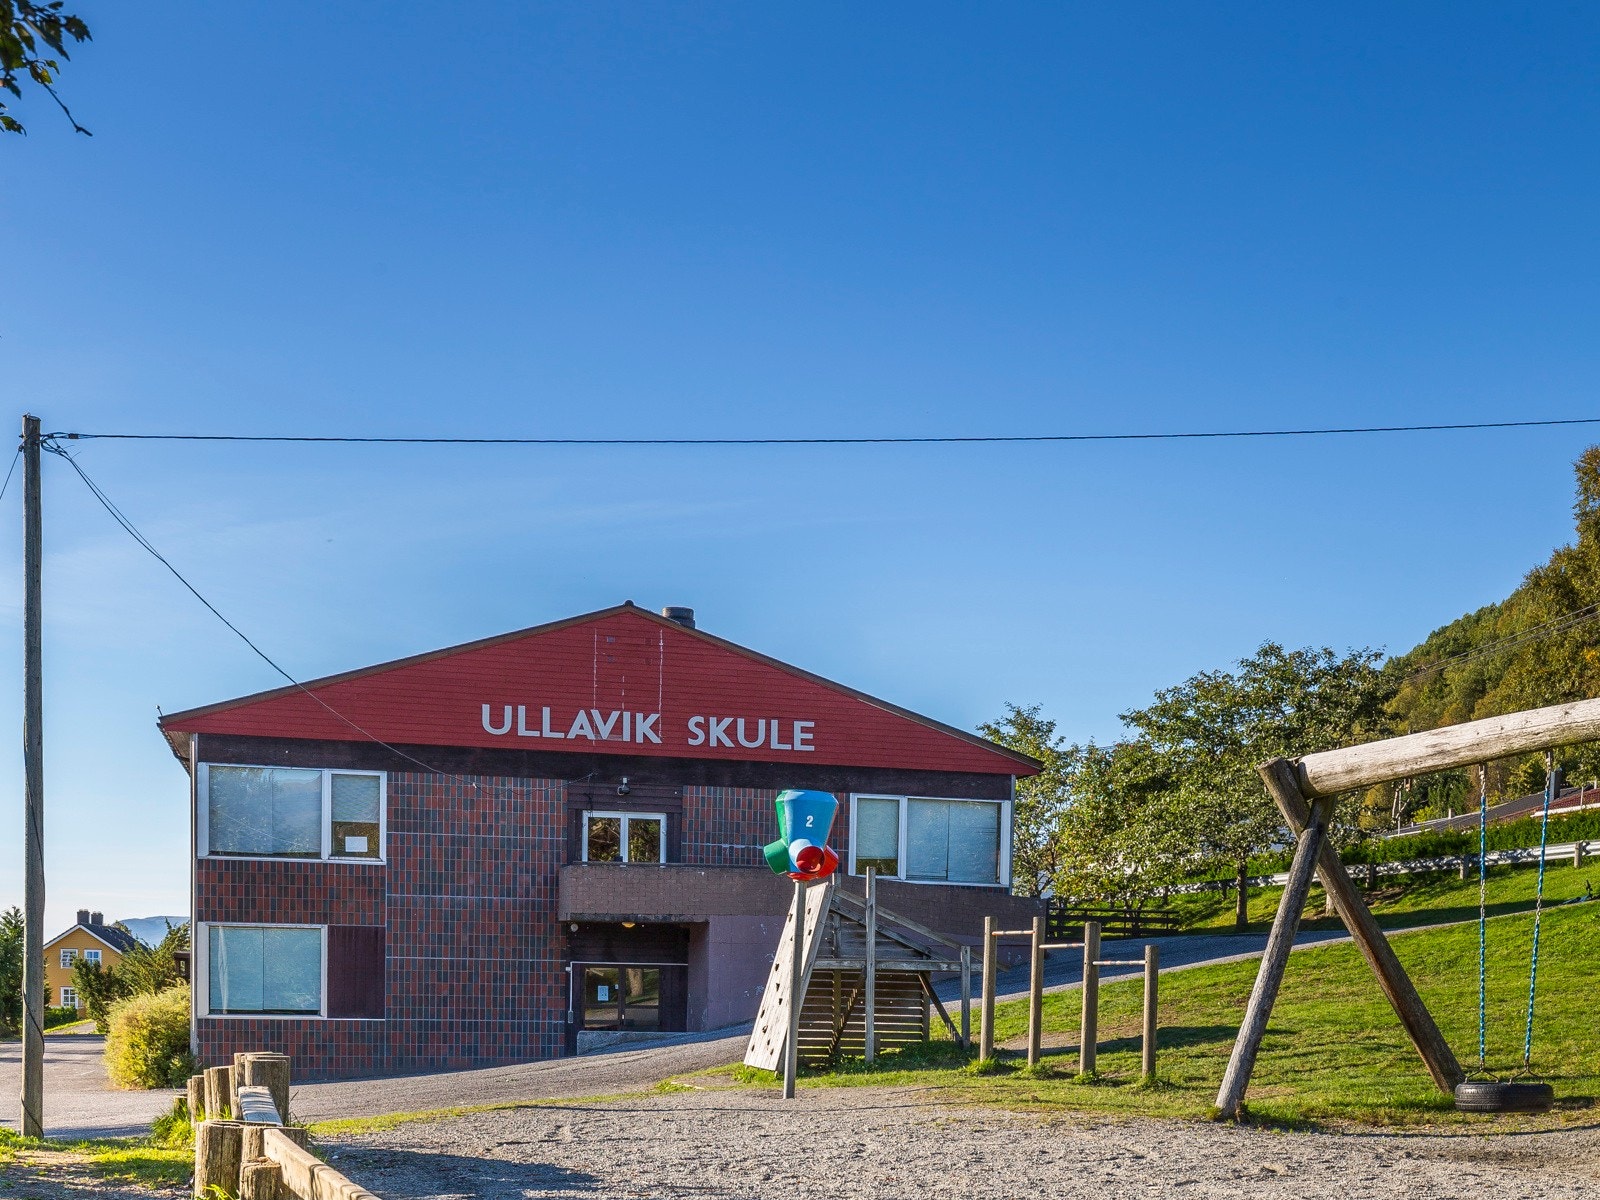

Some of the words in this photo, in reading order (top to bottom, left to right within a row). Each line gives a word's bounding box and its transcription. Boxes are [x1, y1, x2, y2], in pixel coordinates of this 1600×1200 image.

[481, 703, 662, 743] ULLAVIK
[687, 716, 815, 751] SKULE
[805, 815, 814, 828] 2
